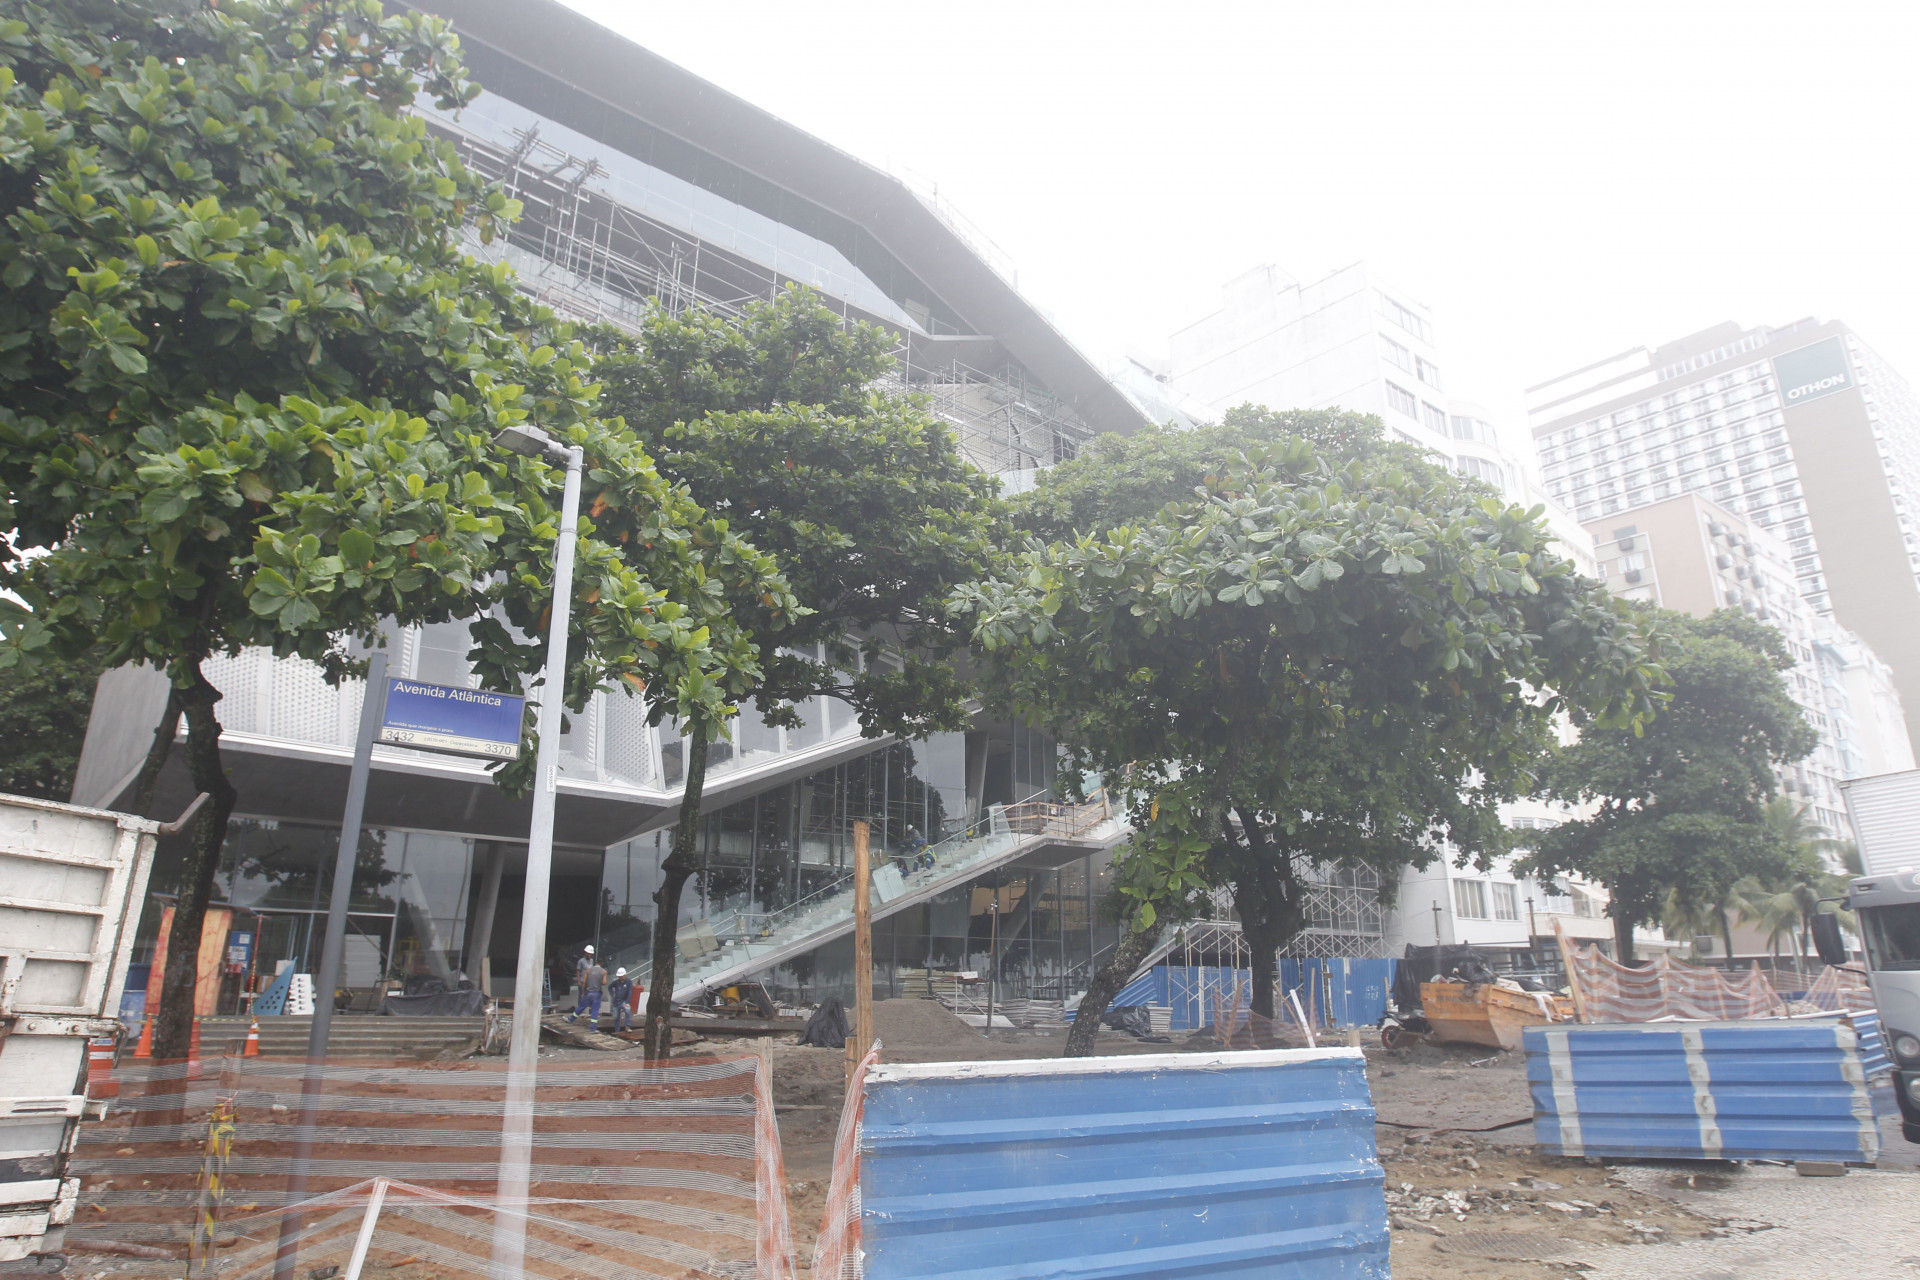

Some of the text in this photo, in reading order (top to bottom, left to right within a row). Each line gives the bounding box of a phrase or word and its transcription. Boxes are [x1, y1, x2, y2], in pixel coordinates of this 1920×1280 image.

[1788, 373, 1845, 399] OTHON
[393, 681, 502, 706] Avenida Atlântica
[385, 730, 415, 742] 3432
[484, 743, 512, 755] 3370
